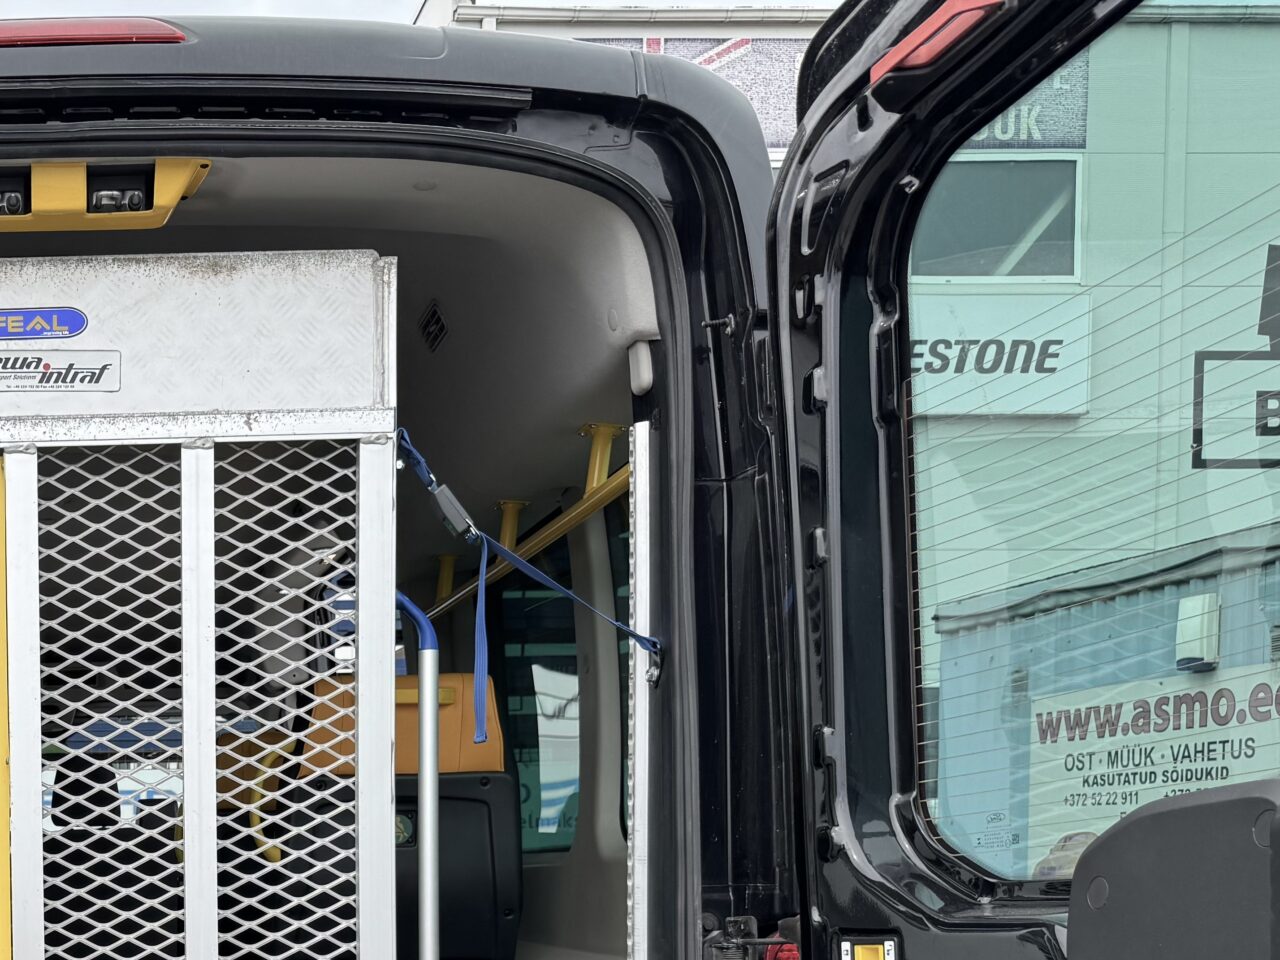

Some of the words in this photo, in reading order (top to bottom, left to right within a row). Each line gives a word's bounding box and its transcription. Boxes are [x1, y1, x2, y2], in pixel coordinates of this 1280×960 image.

[38, 363, 113, 384] intraf
[1035, 682, 1280, 744] www.asmo.e
[1064, 752, 1096, 772] OST
[1107, 744, 1156, 769] MÜÜK
[1169, 737, 1257, 764] VAHETUS
[1082, 771, 1157, 788] KASUTATUD
[1161, 765, 1230, 784] SÕIDUKID
[1063, 793, 1088, 807] +372
[1090, 793, 1104, 806] 52
[1105, 792, 1118, 806] 22
[1120, 791, 1139, 805] 911
